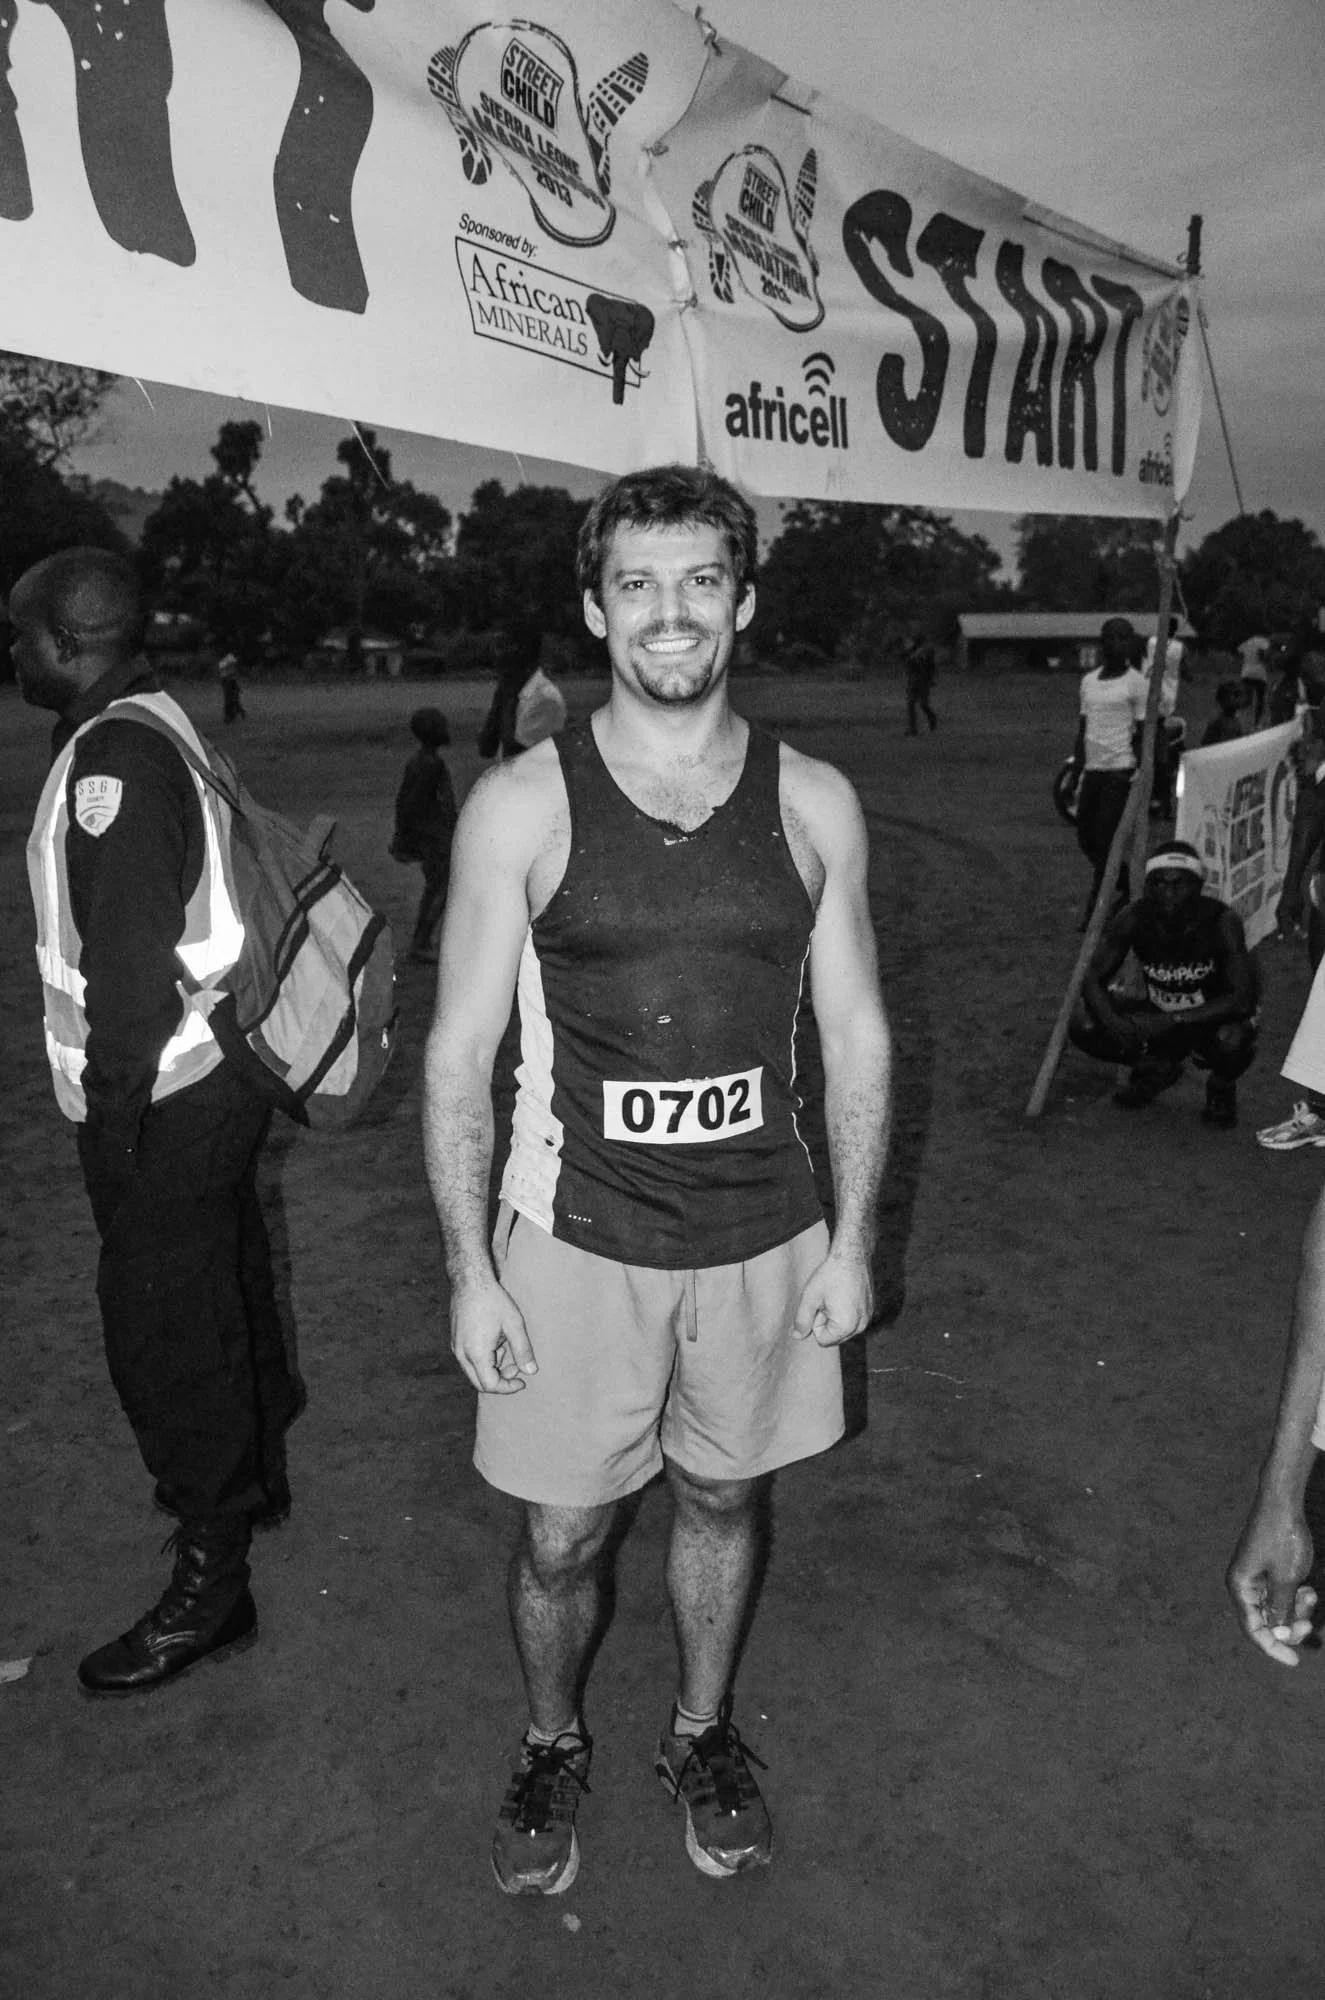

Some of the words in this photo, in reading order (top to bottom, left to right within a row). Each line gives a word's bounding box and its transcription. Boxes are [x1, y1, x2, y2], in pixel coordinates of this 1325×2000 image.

[503, 69, 555, 129] CHILD
[506, 44, 560, 101] STREET
[480, 91, 534, 146] SIERRA
[538, 134, 579, 176] LEONE
[459, 213, 521, 250] Sponsored
[521, 239, 537, 259] by:
[740, 188, 775, 233] CHILD
[470, 253, 588, 326] African
[476, 300, 588, 356] MINERALS
[842, 189, 1143, 476] START
[725, 380, 849, 450] africell
[621, 1078, 751, 1134] 0702
